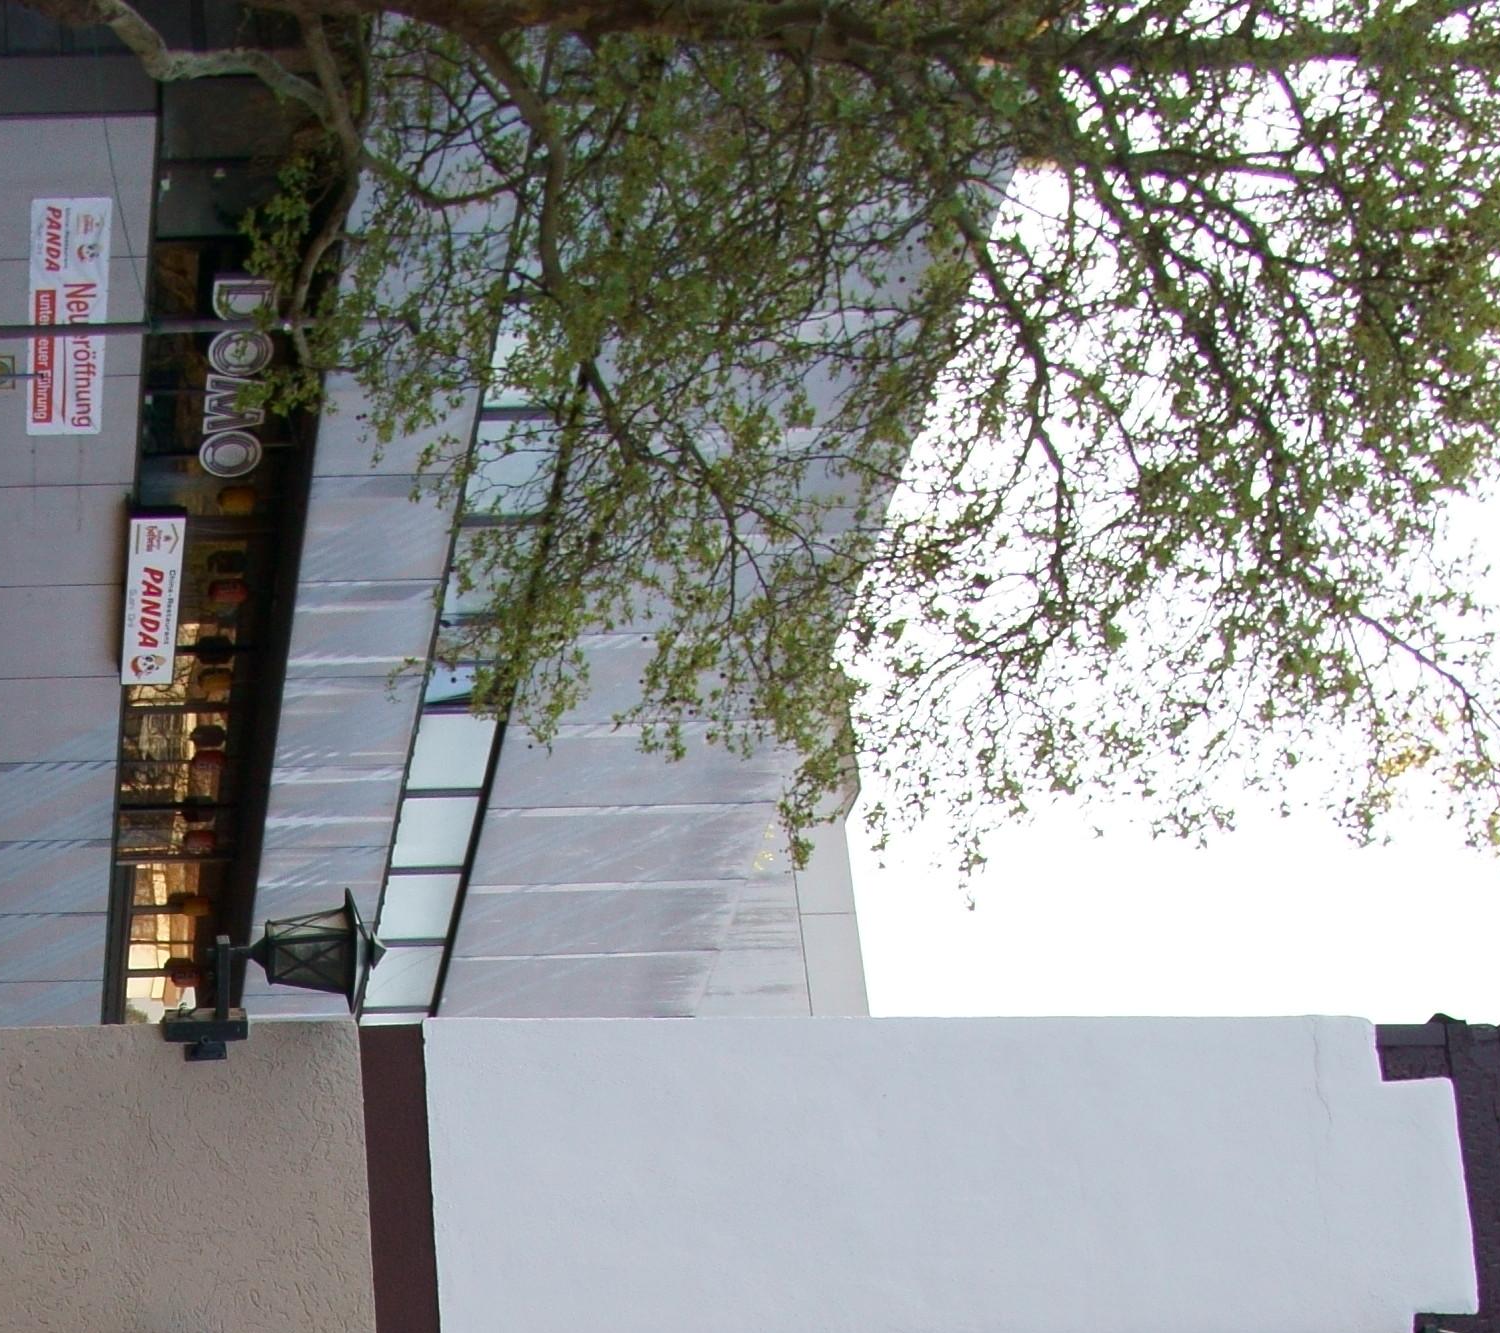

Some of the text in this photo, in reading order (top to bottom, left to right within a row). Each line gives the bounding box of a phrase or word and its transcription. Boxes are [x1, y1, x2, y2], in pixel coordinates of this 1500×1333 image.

[45, 206, 63, 272] PANDA
[199, 278, 276, 478] DOMO
[138, 566, 165, 648] PANDA
